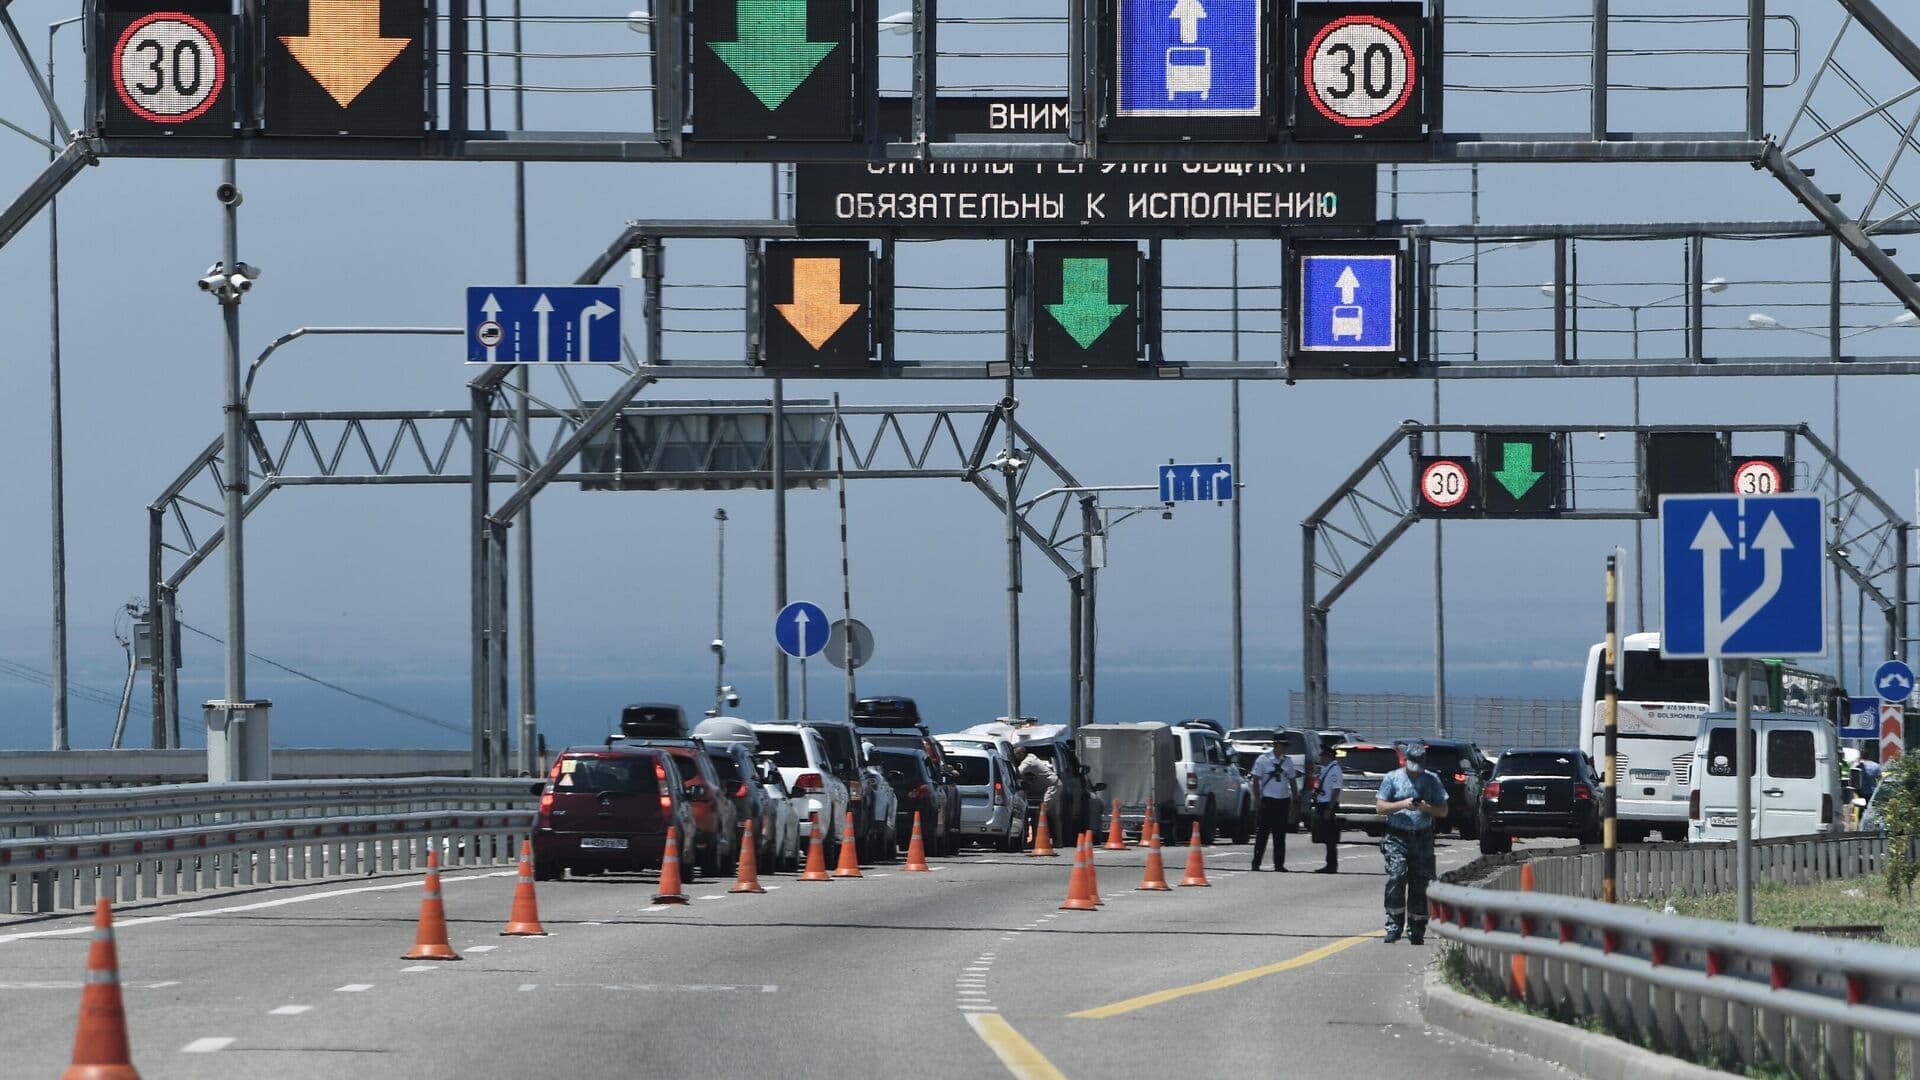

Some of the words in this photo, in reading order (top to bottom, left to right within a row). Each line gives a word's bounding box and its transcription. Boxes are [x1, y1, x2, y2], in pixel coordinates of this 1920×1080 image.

[135, 39, 201, 96] 30
[1327, 43, 1392, 99] 30
[989, 103, 1069, 129] ВНИМ
[835, 192, 1064, 219] ОБЯЗАТЕЛЬНЫ
[1087, 192, 1106, 219] К
[1128, 192, 1337, 219] ИСПОЛНЕНИЮ
[1431, 472, 1459, 495] 30
[1744, 472, 1771, 493] 30
